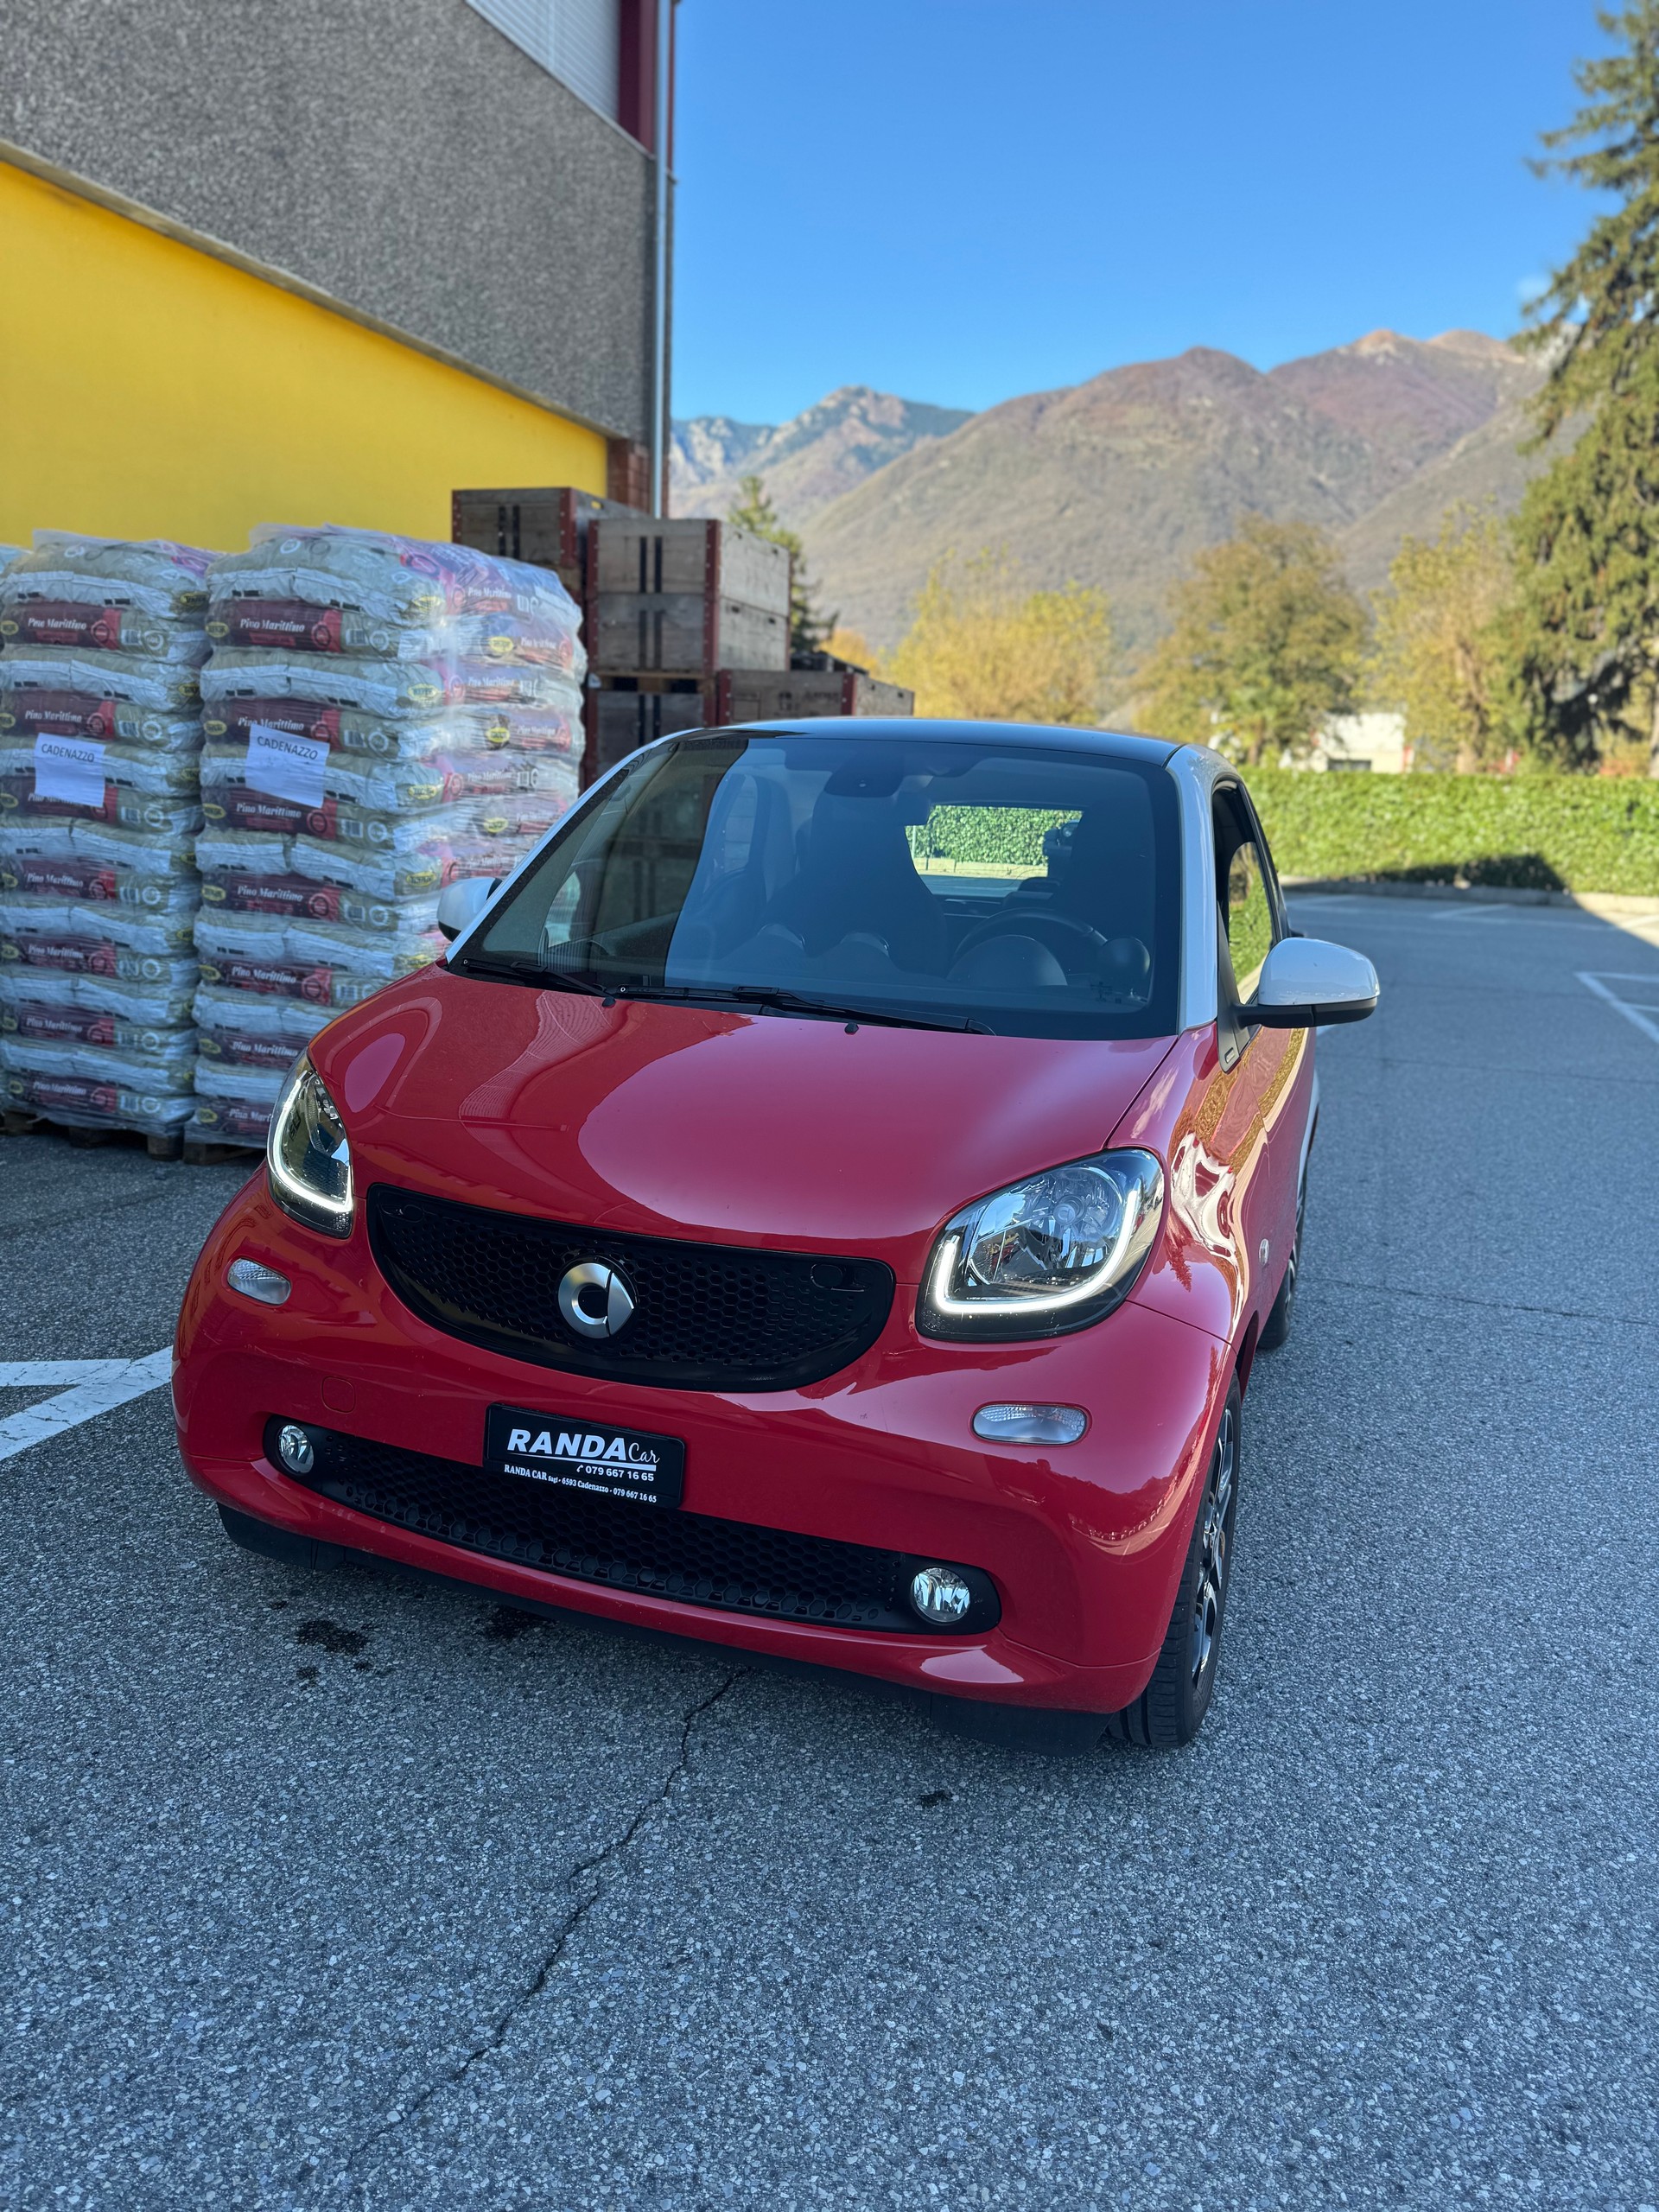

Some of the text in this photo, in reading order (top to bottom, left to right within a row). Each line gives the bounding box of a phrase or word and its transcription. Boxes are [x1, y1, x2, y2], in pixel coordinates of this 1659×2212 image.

[239, 618, 305, 632] Pino Marittimo
[25, 710, 41, 721] Pino
[42, 711, 82, 723] Marittimo
[41, 743, 95, 763] CADENAZZO
[257, 735, 318, 761] CADENAZZO
[236, 803, 256, 814] Pino
[257, 804, 302, 818] Marittimo
[237, 886, 257, 897] Pino
[258, 887, 303, 902] Marittimo
[232, 966, 251, 977] Pino
[252, 969, 297, 984] Marittimo
[232, 1041, 251, 1052] Pino
[253, 1043, 298, 1057] Marittimo
[507, 1428, 660, 1464] RANDA Car
[585, 1465, 654, 1482] 079 667 16 65
[504, 1464, 531, 1478] RANDA
[531, 1470, 548, 1481] CAR
[562, 1477, 577, 1487] 6593
[577, 1480, 609, 1493] Cadenazzo
[613, 1487, 626, 1497] 079
[626, 1490, 639, 1500] 667
[648, 1494, 657, 1503] 65
